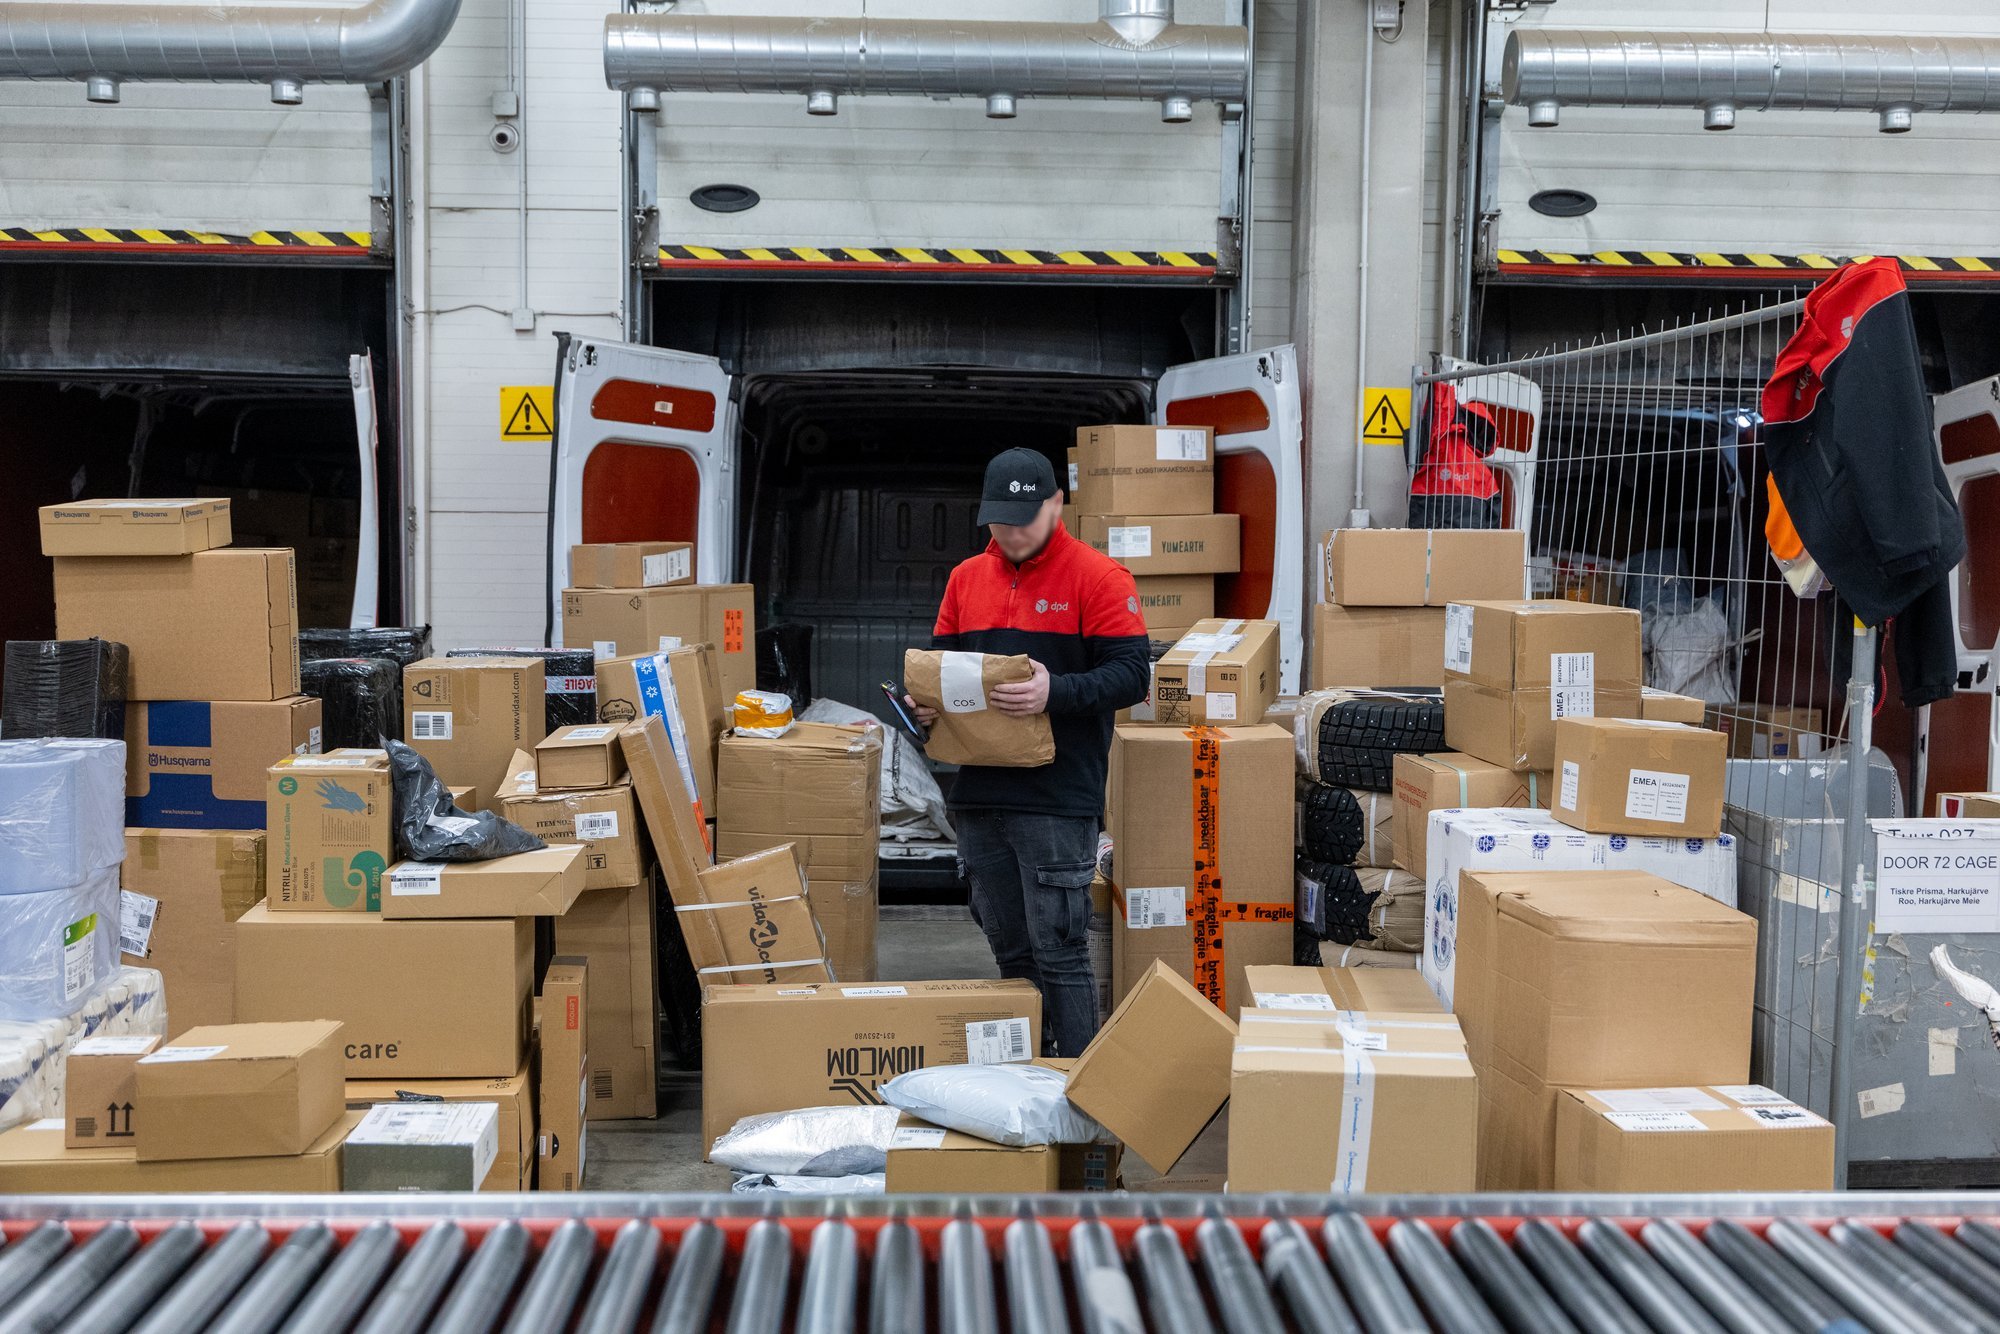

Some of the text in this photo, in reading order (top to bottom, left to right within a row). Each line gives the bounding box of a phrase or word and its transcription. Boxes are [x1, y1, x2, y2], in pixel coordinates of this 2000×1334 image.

[1022, 483, 1036, 493] dpd
[1161, 541, 1204, 553] YUMEARTH
[1050, 602, 1069, 612] dpd
[1140, 594, 1182, 607] YUMEARTH
[565, 679, 597, 690] RAGILE
[1159, 688, 1167, 700] 8
[511, 672, 520, 741] www.vidaxl.com
[953, 699, 976, 707] COS
[1556, 692, 1564, 717] EMEA
[160, 755, 211, 767] Husqvarna
[1633, 777, 1657, 786] EMEA
[536, 820, 556, 828] ITEM
[1198, 785, 1209, 850] breekbaar
[283, 823, 291, 841] Exam
[283, 842, 291, 866] Medical
[1883, 856, 1997, 869] DOOR 72 CAGE
[371, 866, 380, 888] AQUA
[282, 867, 291, 902] NITRILE
[1916, 888, 1945, 896] Prisma,
[1947, 888, 1989, 896] Harkujärve
[1898, 897, 1980, 906] Roo, Harkujärve Meie
[1205, 896, 1219, 936] fragile
[1255, 907, 1293, 921] fragile
[568, 998, 576, 1027] Lenovo
